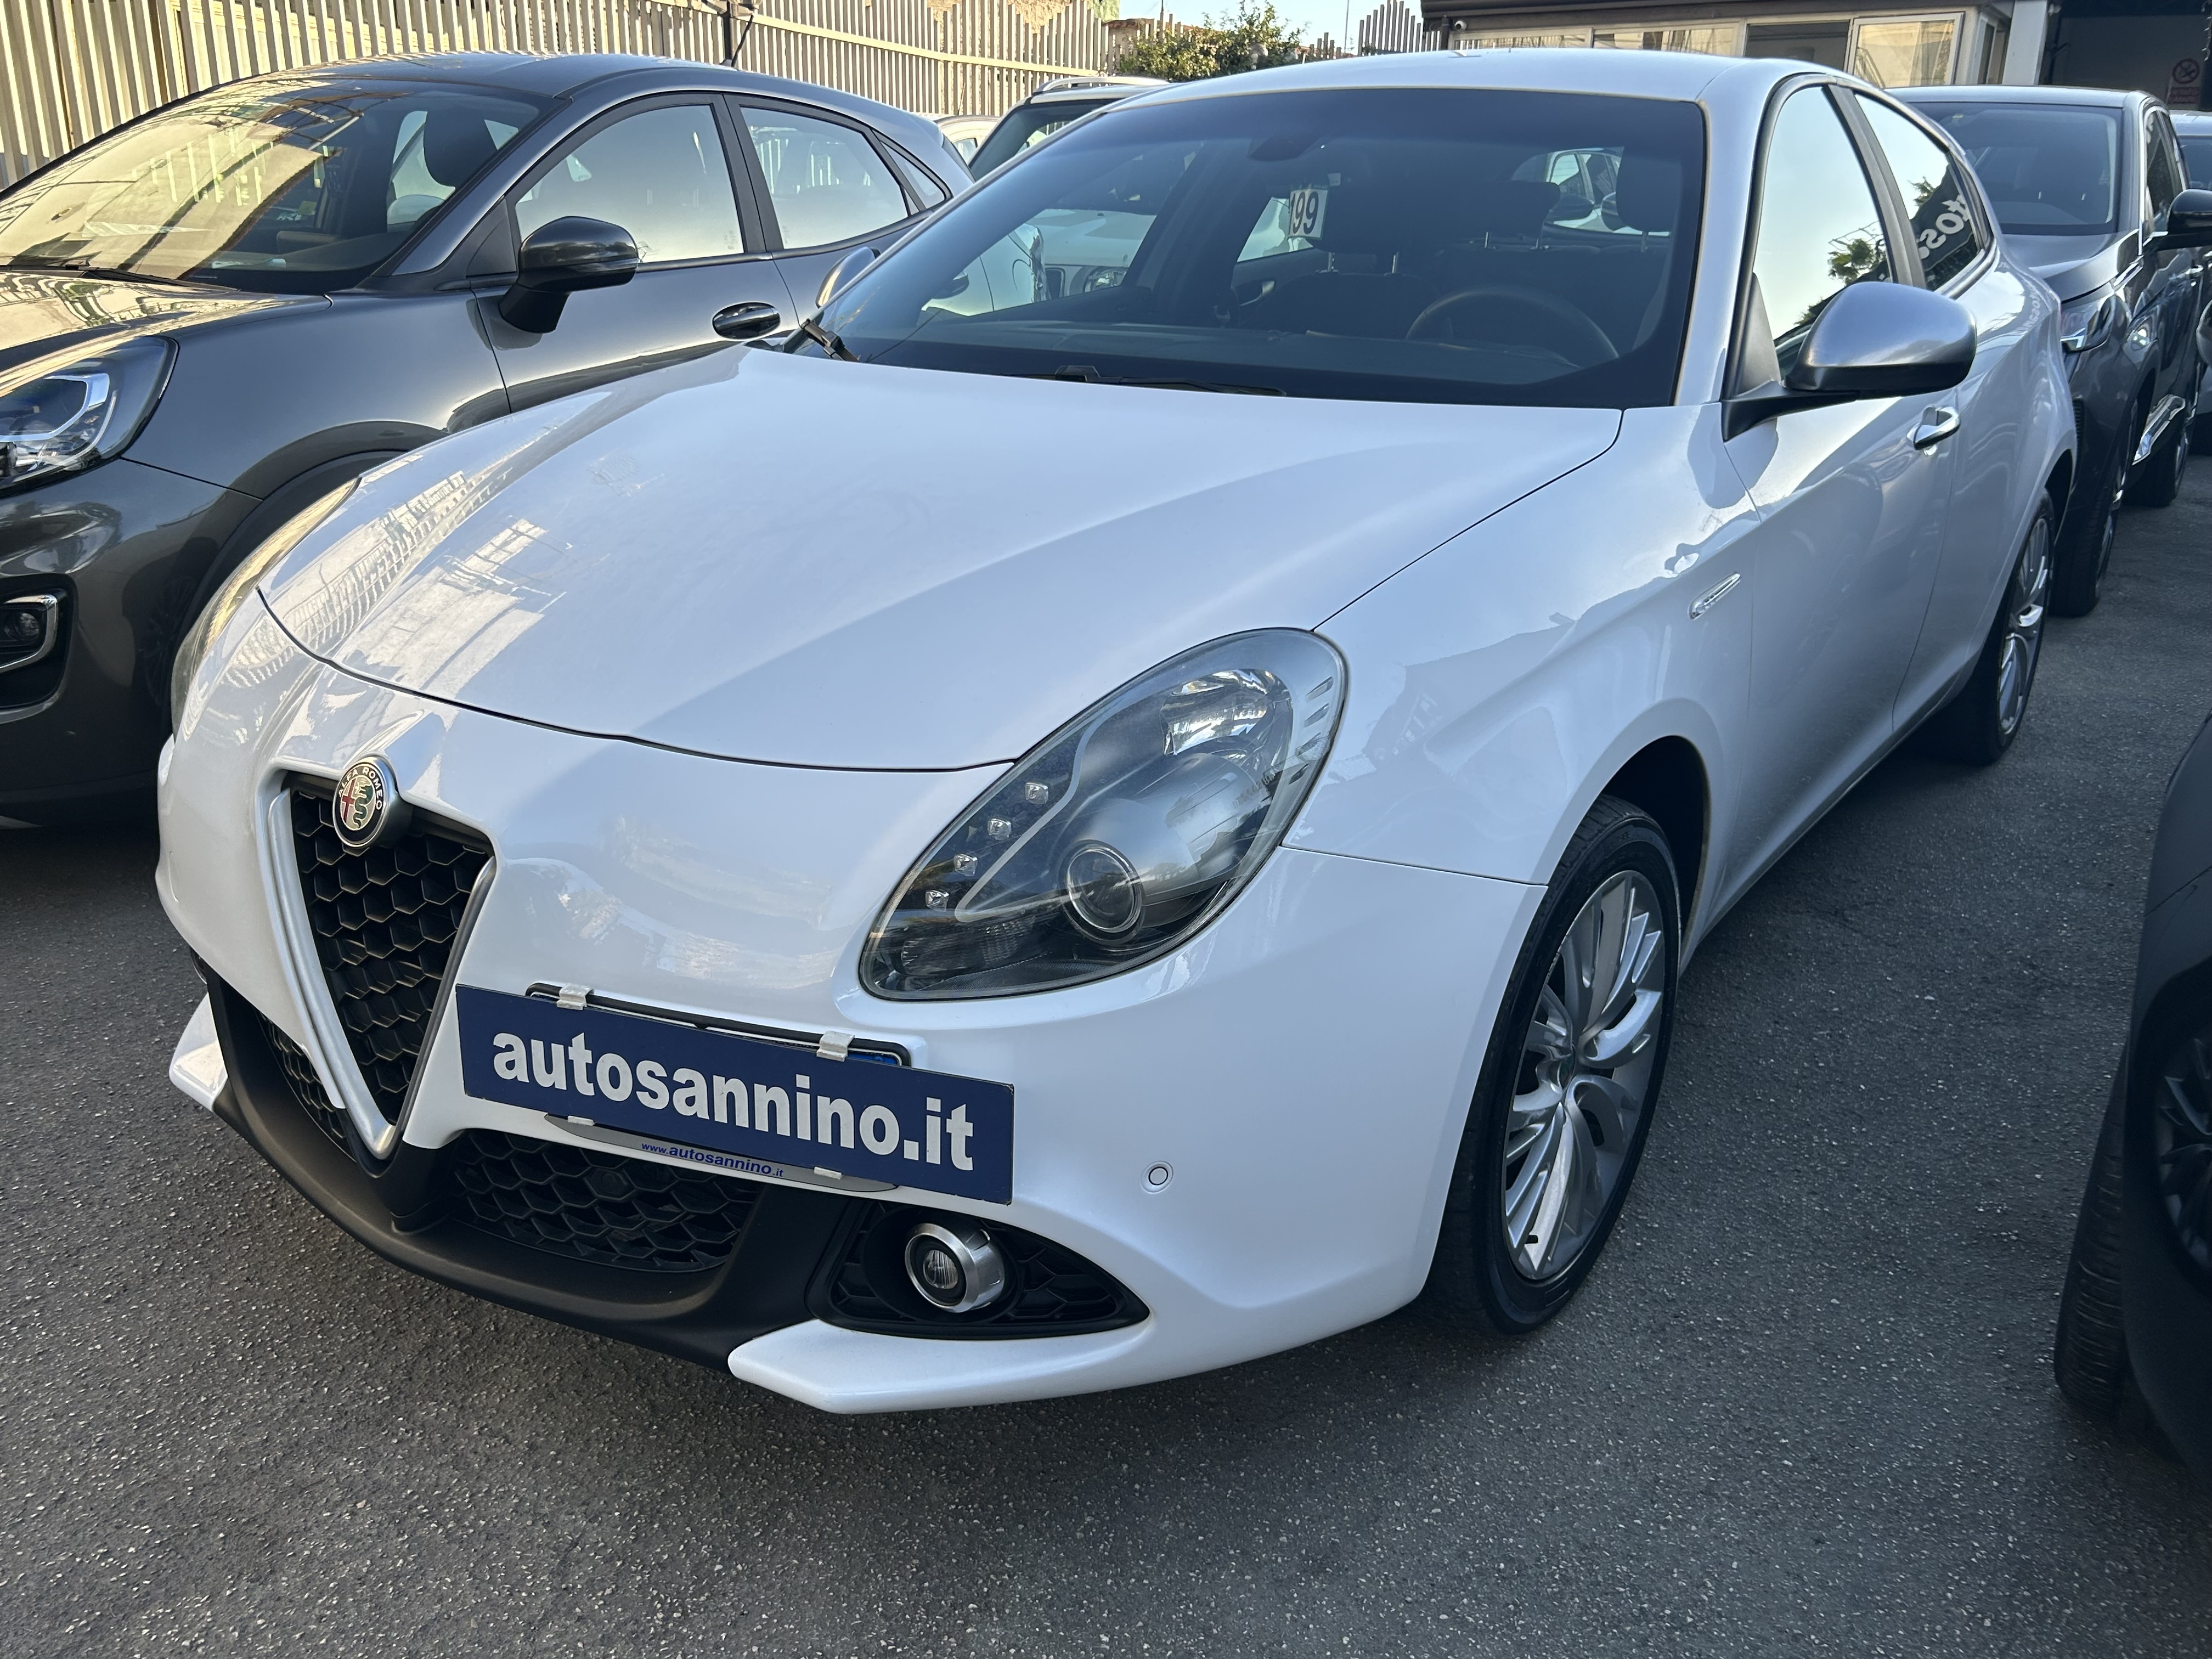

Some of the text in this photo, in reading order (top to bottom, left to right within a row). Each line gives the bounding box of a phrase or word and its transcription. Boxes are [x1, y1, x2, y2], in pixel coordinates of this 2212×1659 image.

[338, 767, 383, 810] ALFA ROMEO
[493, 1032, 974, 1171] autosannino.it
[641, 1143, 783, 1177] www.autosannino.it
